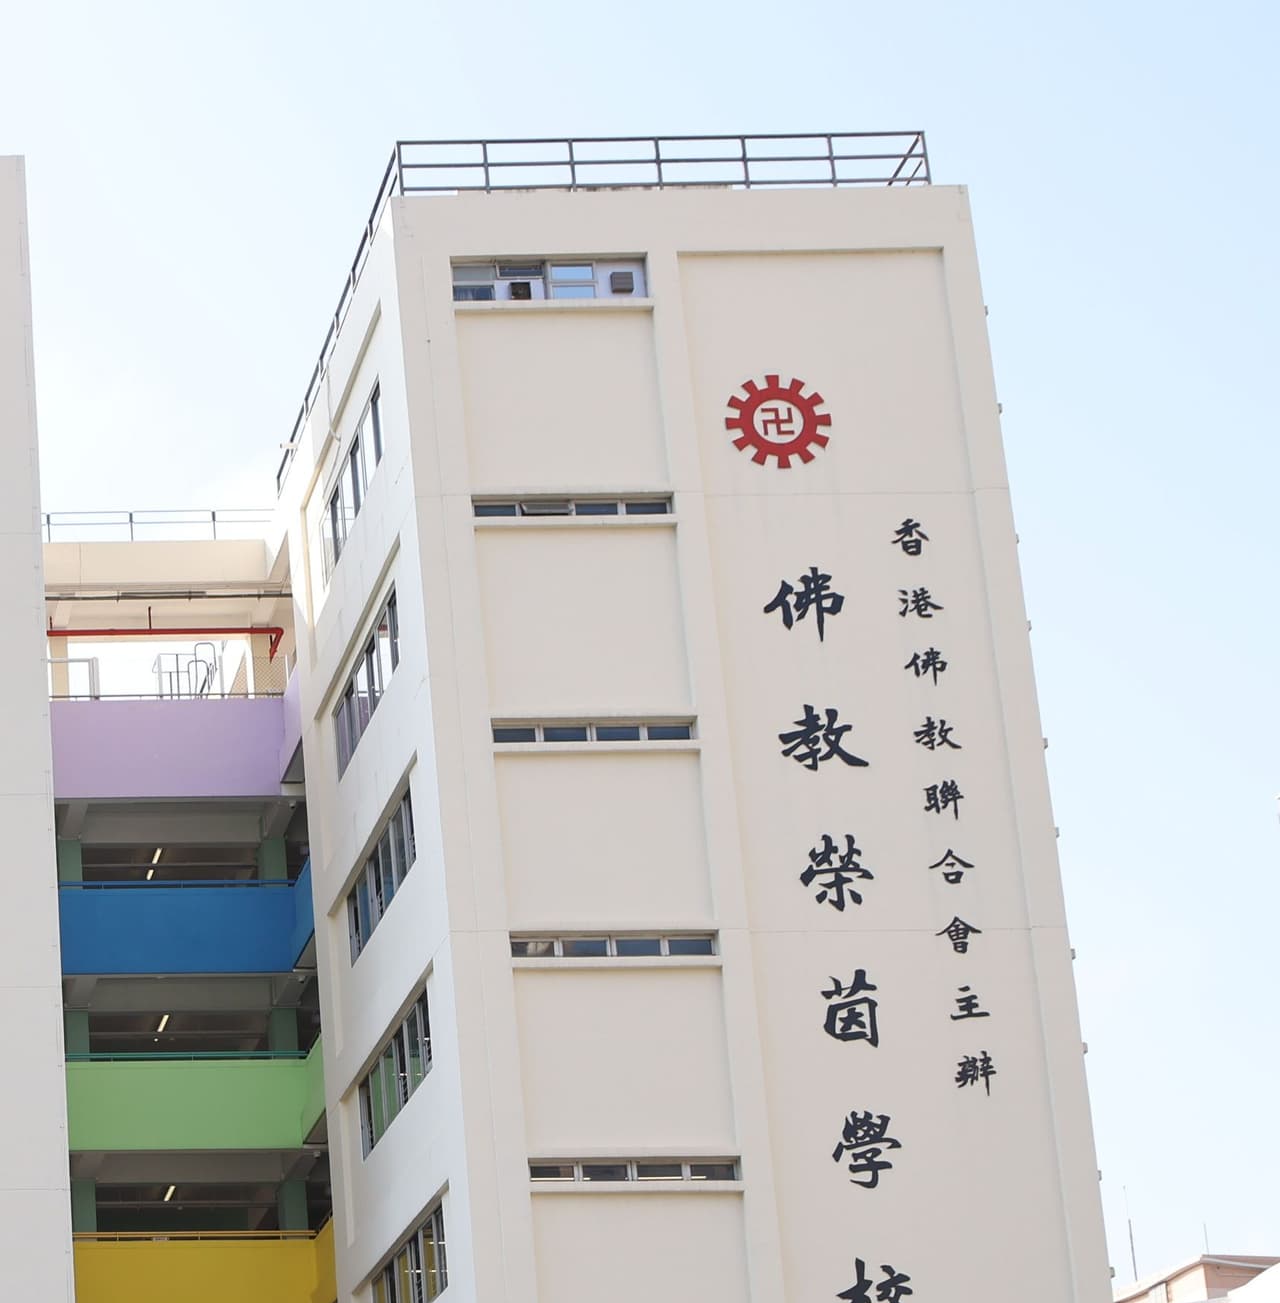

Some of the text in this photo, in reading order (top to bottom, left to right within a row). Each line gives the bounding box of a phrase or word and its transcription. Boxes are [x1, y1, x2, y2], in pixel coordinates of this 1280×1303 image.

[891, 518, 997, 1097] 香港佛教聯合會主辦
